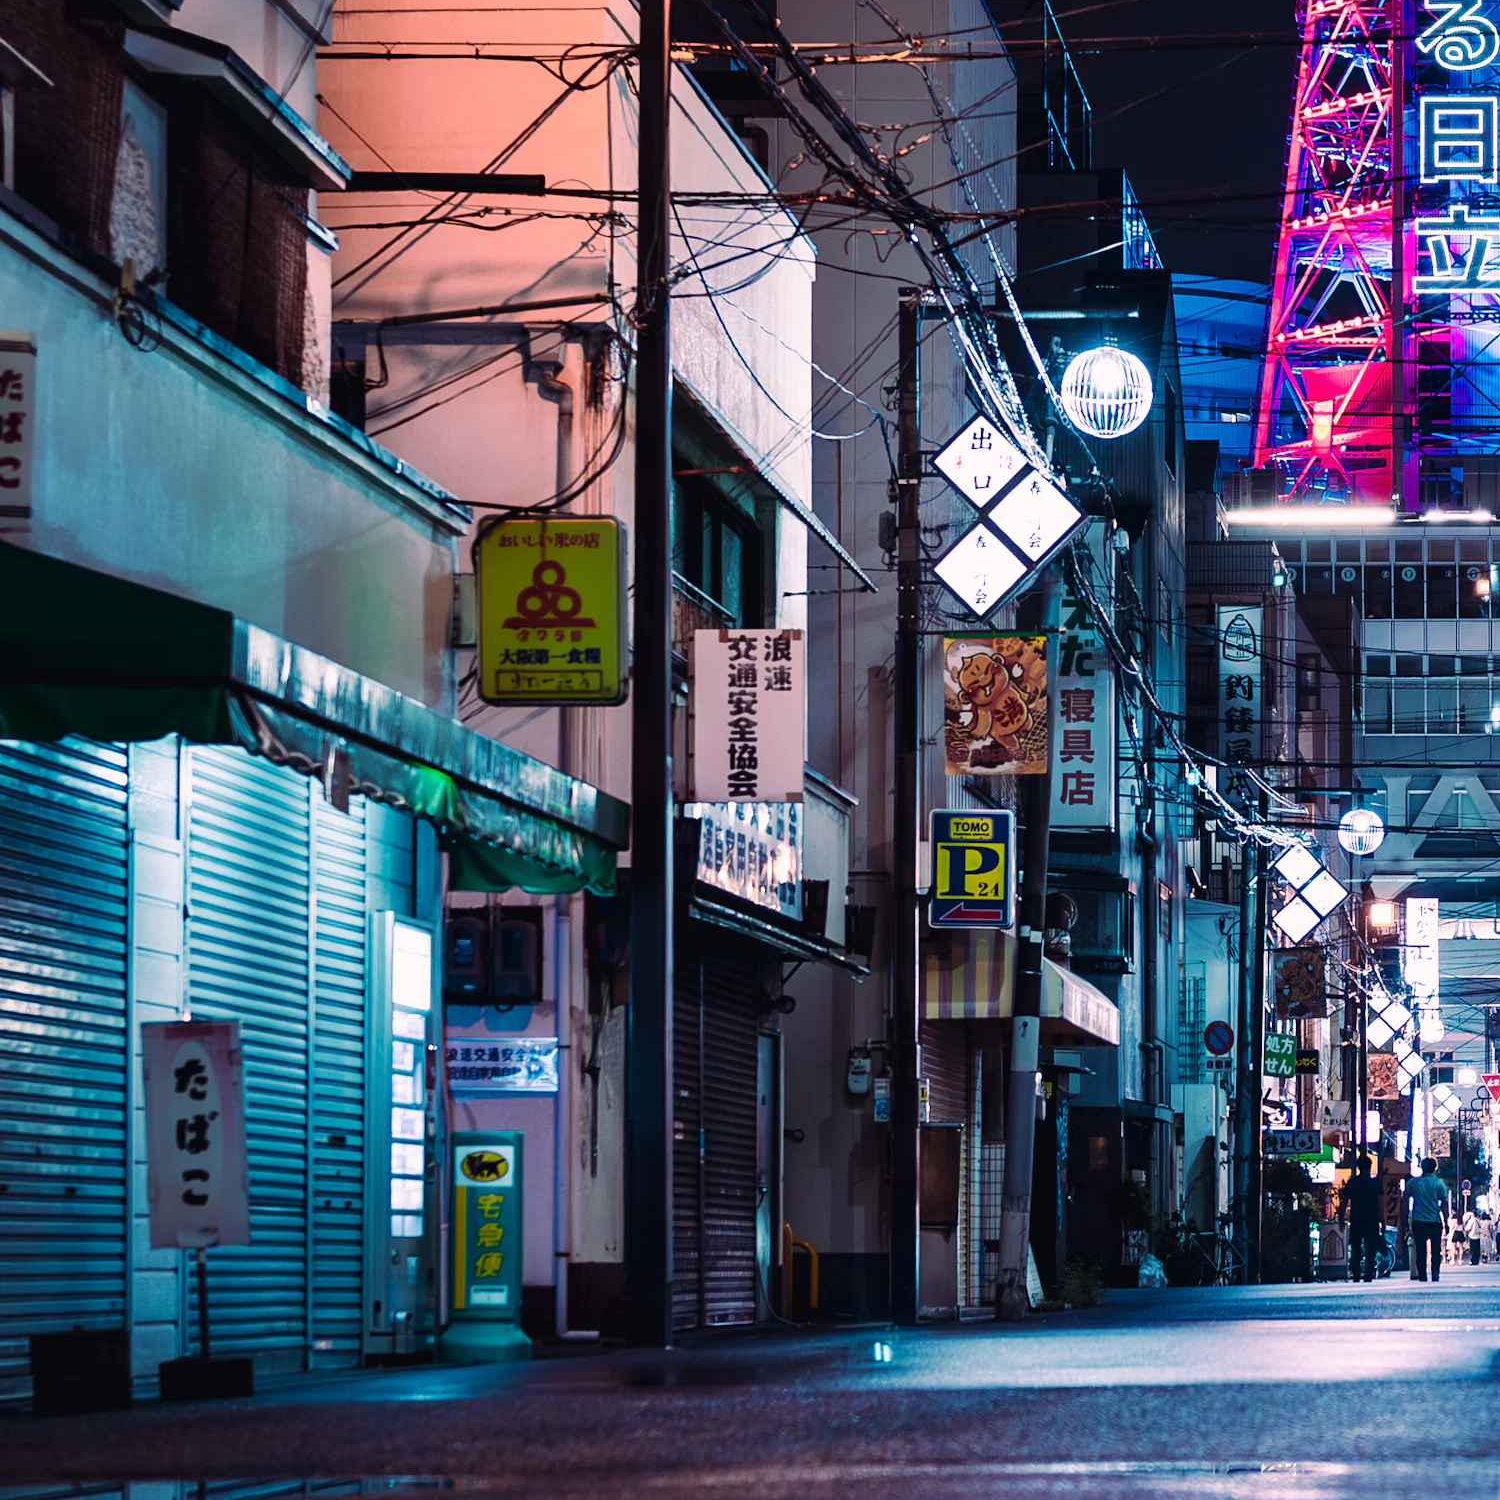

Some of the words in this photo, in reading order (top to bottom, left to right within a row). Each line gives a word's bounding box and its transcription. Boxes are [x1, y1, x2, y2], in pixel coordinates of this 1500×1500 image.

[499, 532, 601, 549] おいしい米の店
[764, 634, 792, 691] 浪速
[727, 634, 758, 797] 交通安全協会
[953, 822, 989, 831] TOMO
[940, 845, 1000, 896] P
[978, 882, 1000, 896] 24
[1266, 1035, 1294, 1055] 処方
[1265, 1058, 1293, 1076] せん
[174, 1058, 219, 1207] たばこ
[475, 1194, 505, 1278] 宅急便
